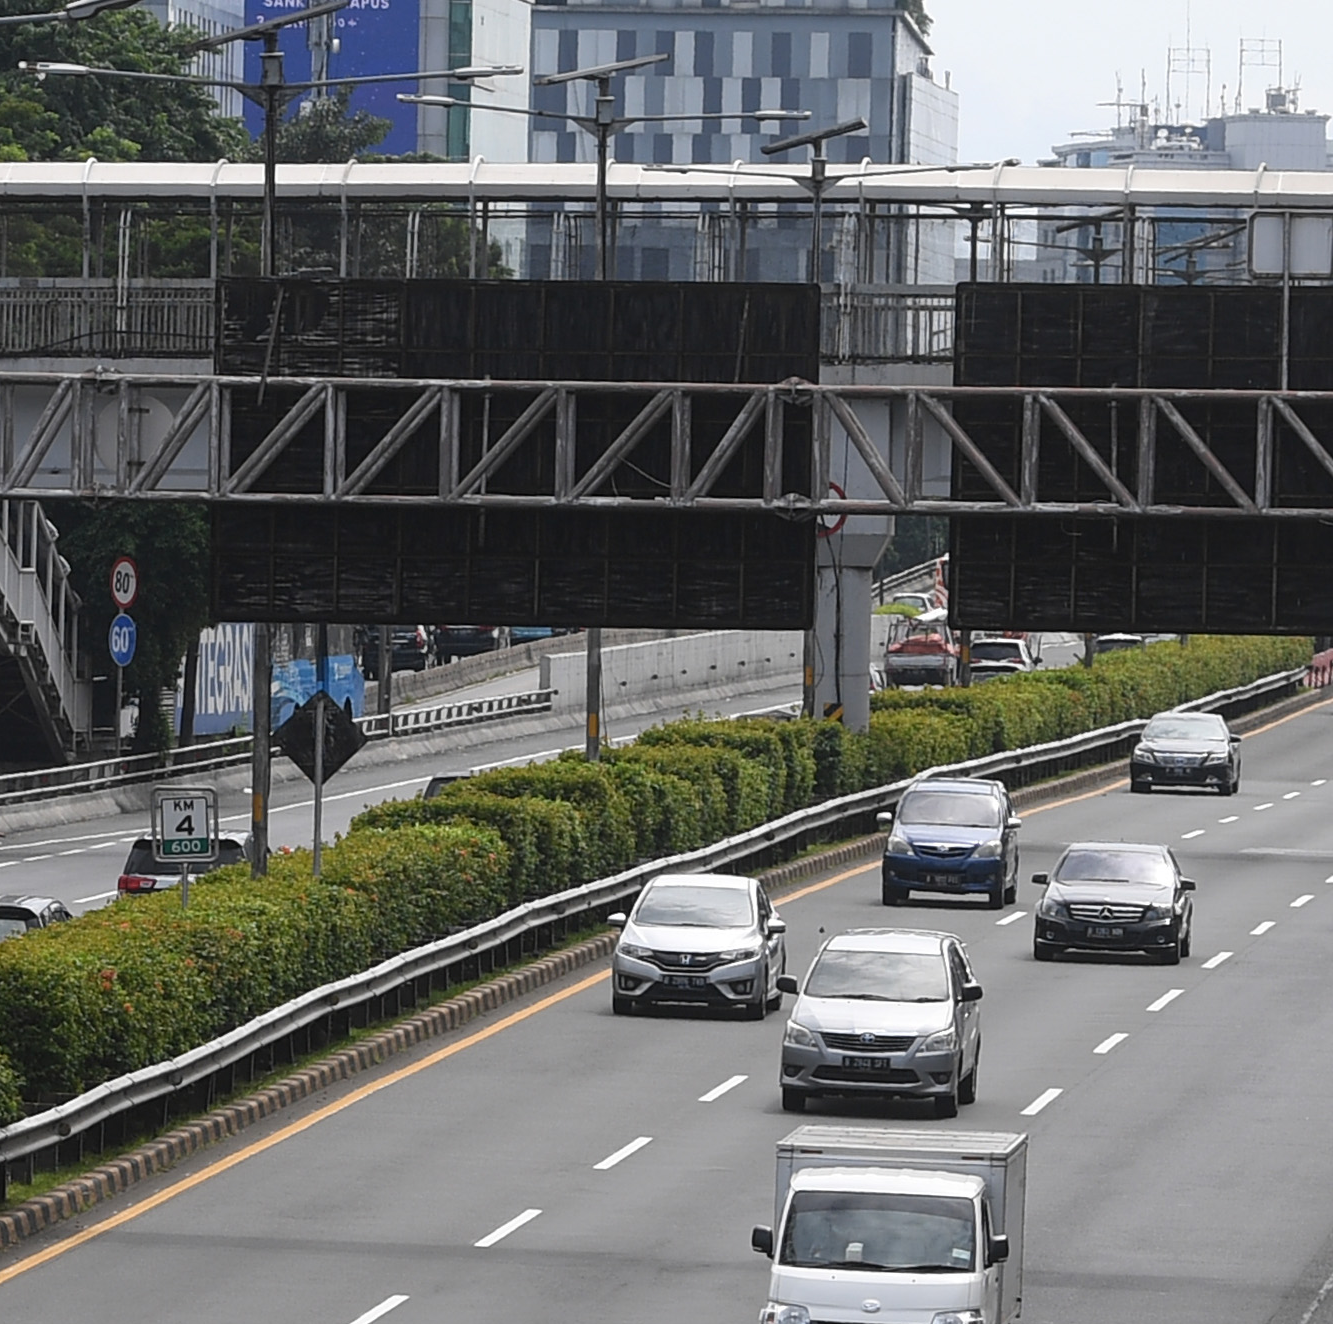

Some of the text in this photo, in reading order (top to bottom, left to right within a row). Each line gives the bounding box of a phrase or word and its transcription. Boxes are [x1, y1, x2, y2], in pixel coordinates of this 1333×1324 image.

[114, 570, 130, 594] 80
[112, 625, 129, 653] 60
[173, 800, 195, 812] KM
[175, 814, 195, 836] 4
[171, 840, 201, 853] 600
